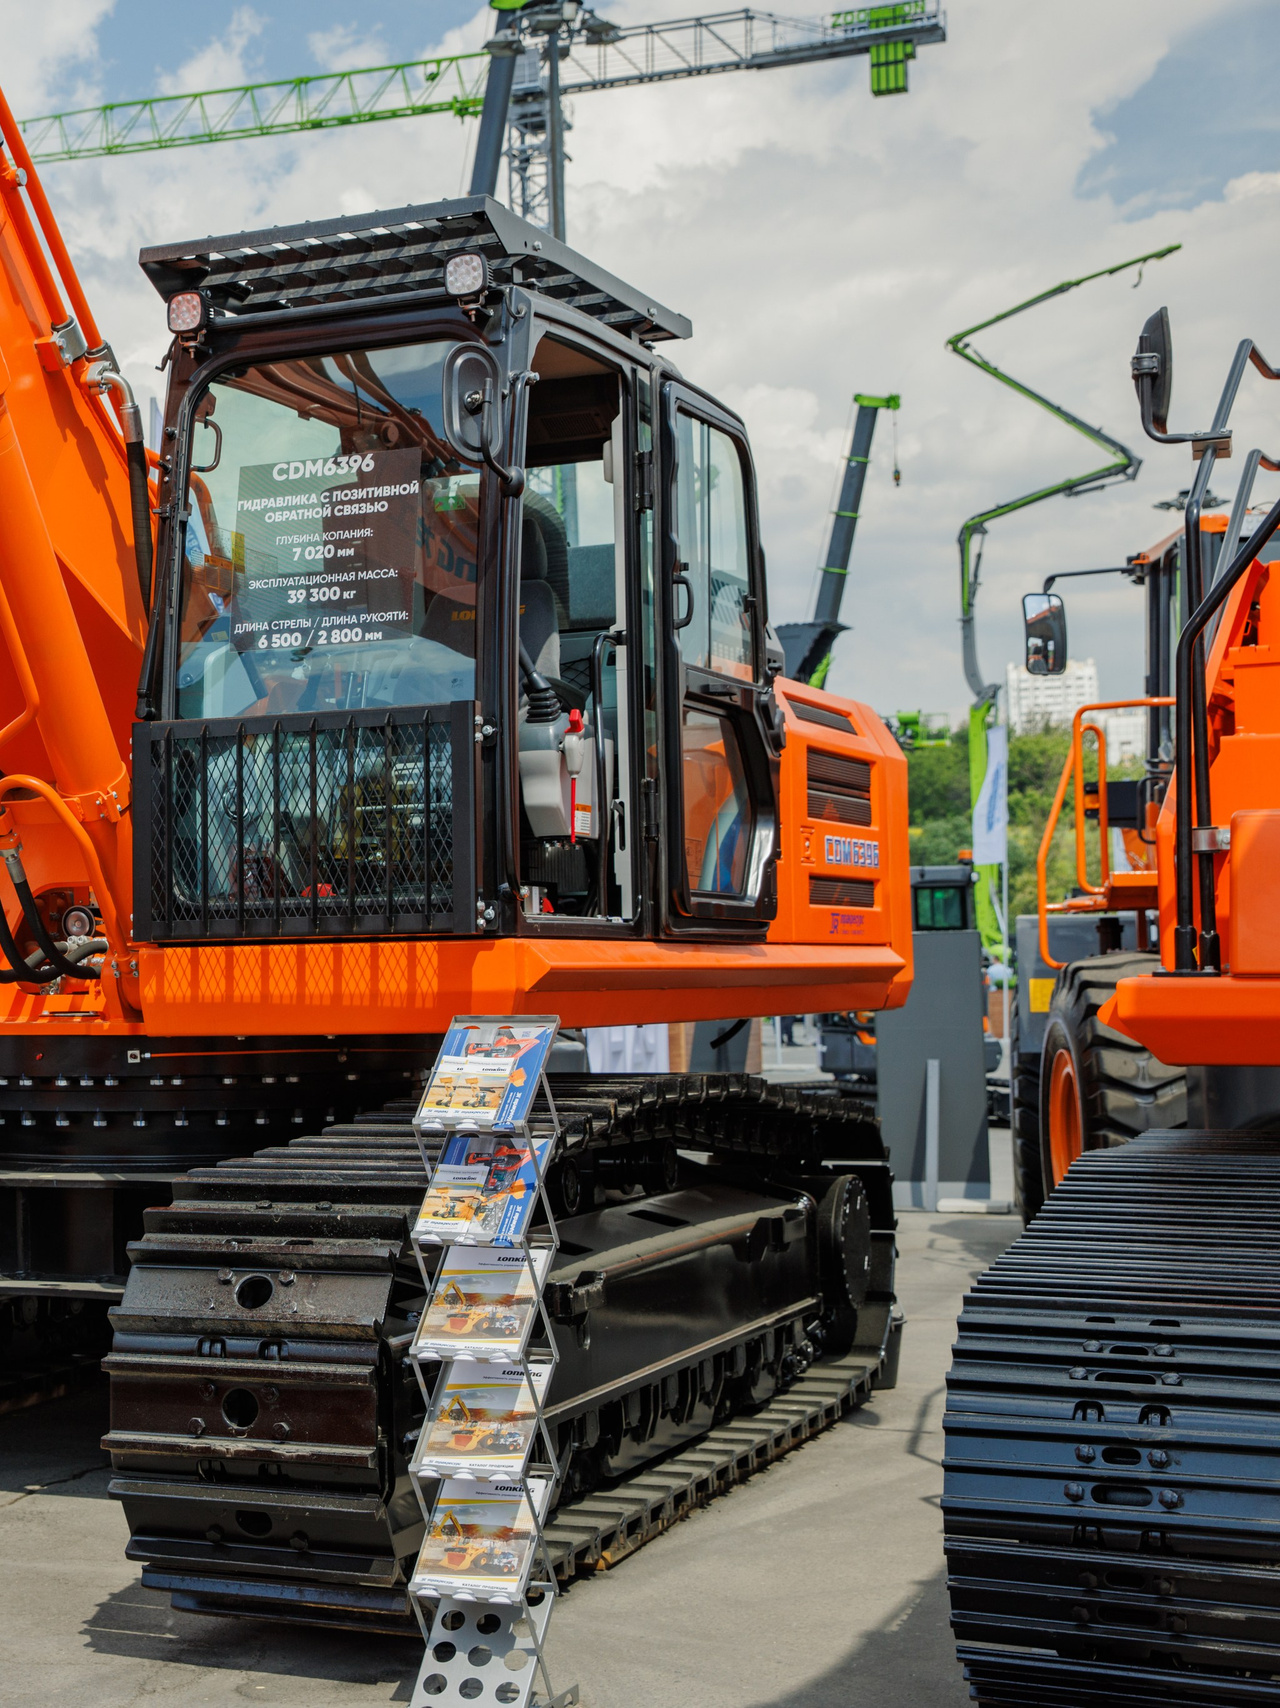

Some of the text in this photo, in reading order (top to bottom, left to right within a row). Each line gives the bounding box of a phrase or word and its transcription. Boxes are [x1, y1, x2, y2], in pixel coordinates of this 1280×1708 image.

[831, 0, 925, 28] ZOOON
[272, 454, 375, 481] CDM6396
[237, 493, 318, 512] ГИДРАВЛИКА
[332, 480, 420, 502] ПОЗИТИВНОЙ
[265, 501, 388, 523] ОБРАТНОЙ СВЯЗЬЮ
[276, 528, 374, 546] ГЛУБИНА КОПАНИЯ:
[292, 545, 355, 561] 7 020 мм
[248, 571, 356, 590] ЭКСПЛУАТАЦИОННАЯ
[357, 568, 398, 581] МАССА:
[287, 586, 356, 604] 39 300 кг
[234, 621, 269, 635] ДЛИНА
[271, 617, 312, 631] СТРЕЛЫ
[321, 614, 358, 628] ДЛИНА
[360, 610, 409, 626] РУКОЯТИ:
[257, 634, 268, 649] 6
[271, 633, 302, 648] 500
[317, 630, 328, 645] 2
[330, 627, 363, 644] 800
[365, 631, 383, 641] мм
[824, 835, 880, 869] CDM6396
[502, 1370, 543, 1378] LONKNG
